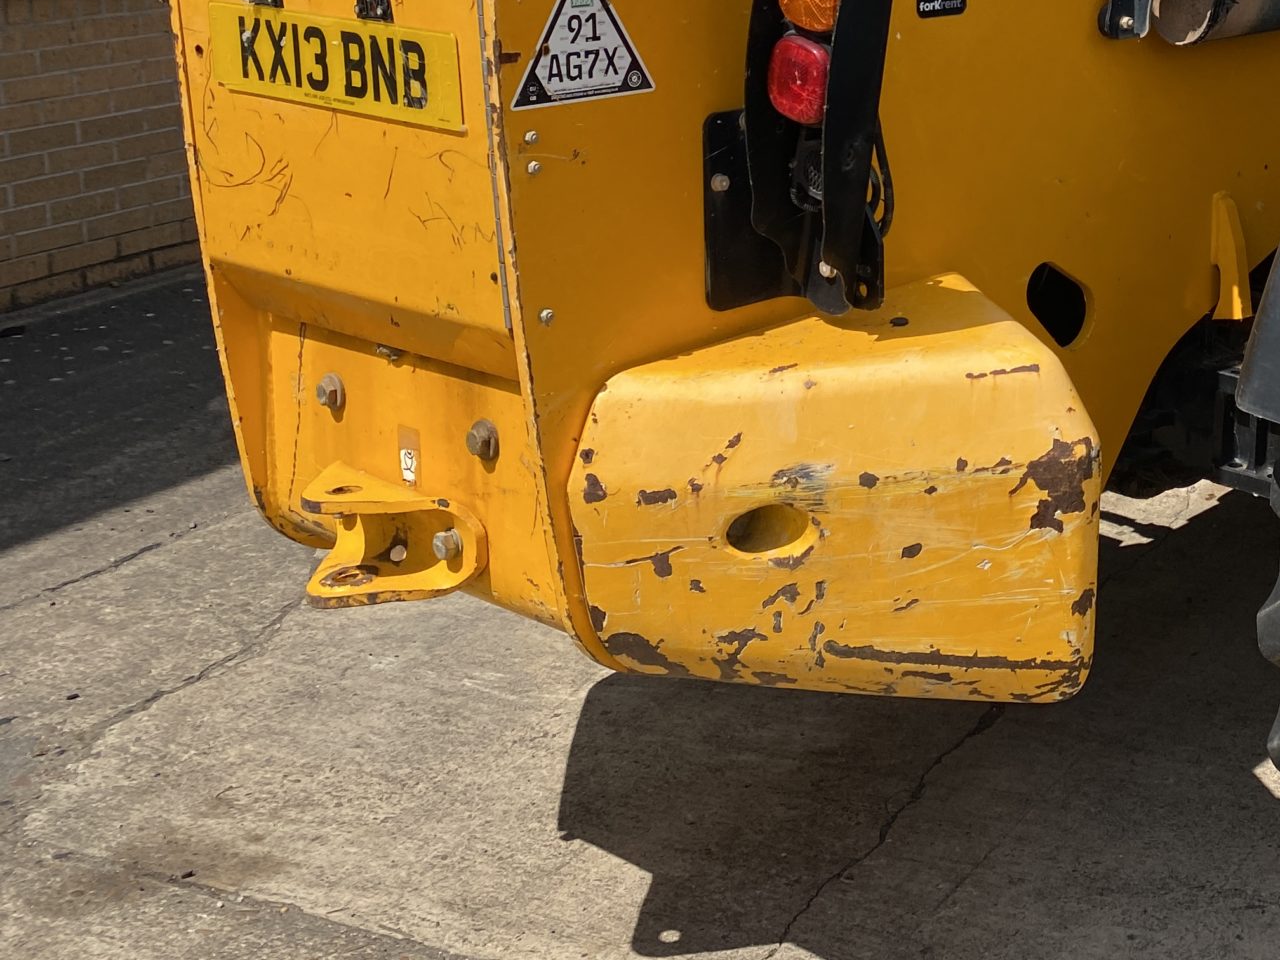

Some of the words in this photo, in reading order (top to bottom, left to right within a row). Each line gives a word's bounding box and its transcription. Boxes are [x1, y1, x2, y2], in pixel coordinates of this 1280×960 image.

[567, 12, 601, 44] 91
[240, 17, 329, 91] KX13
[341, 32, 427, 109] BNB
[547, 47, 620, 85] AG7X
